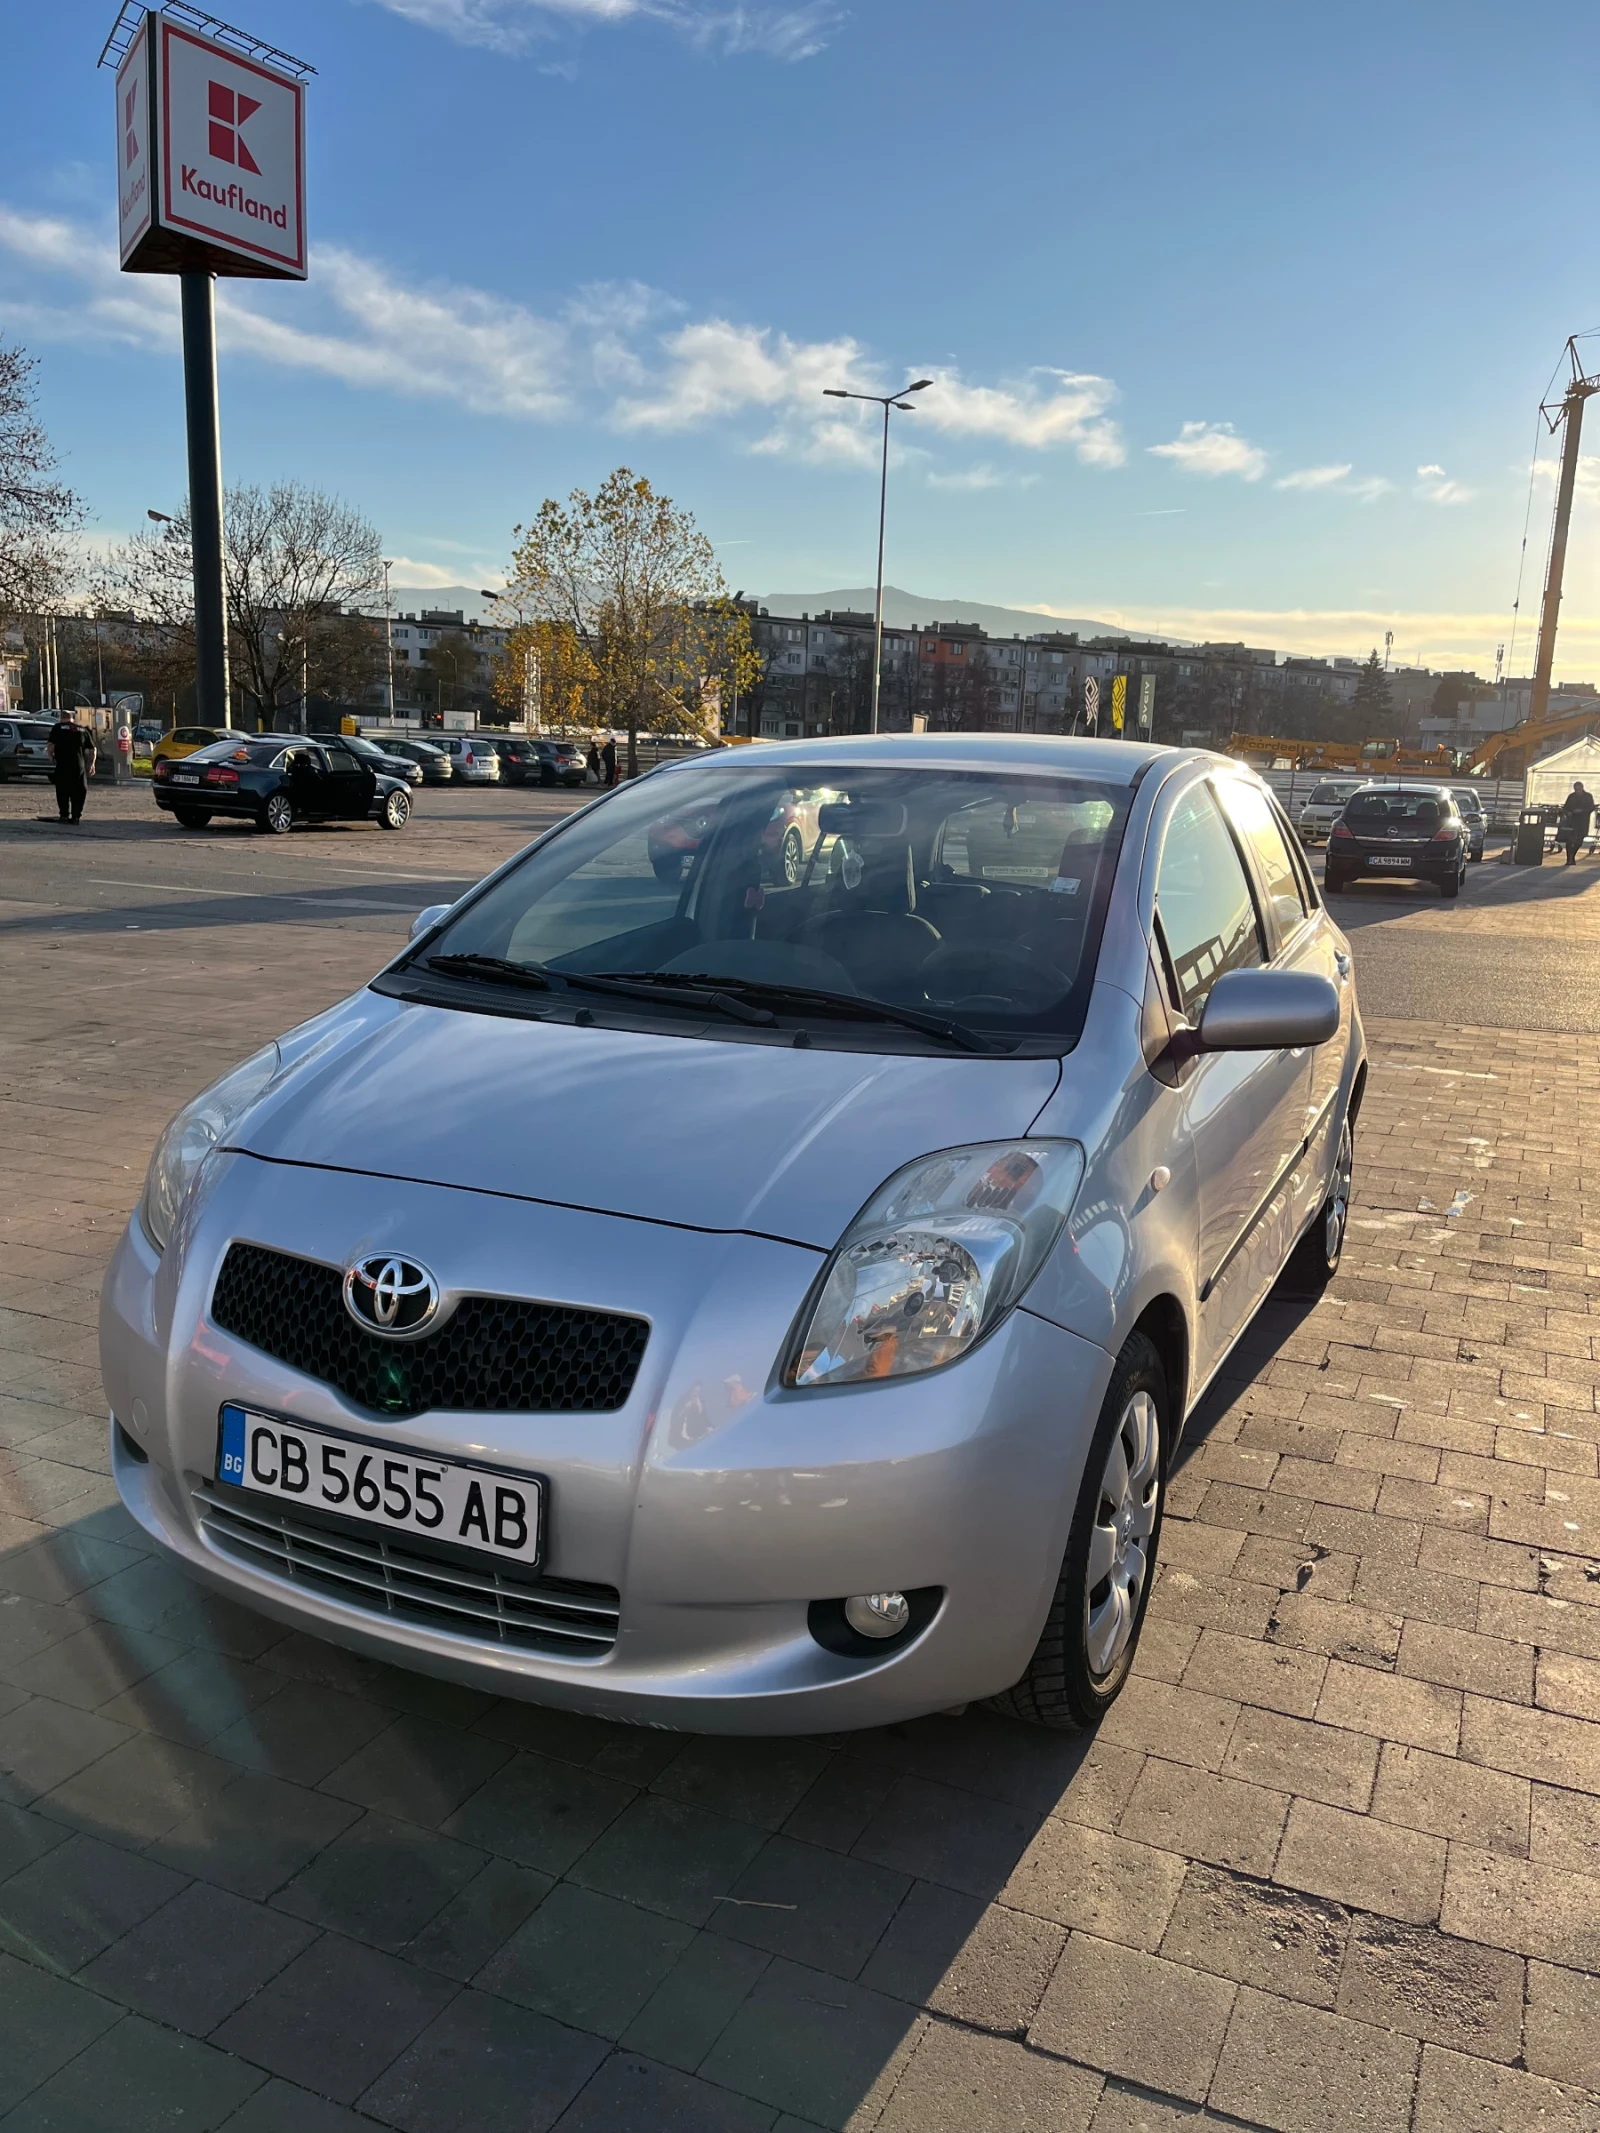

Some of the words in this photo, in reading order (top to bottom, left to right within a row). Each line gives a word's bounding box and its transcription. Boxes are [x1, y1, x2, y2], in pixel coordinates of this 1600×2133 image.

[181, 164, 286, 230] Kaufland
[223, 1453, 242, 1474] BG
[251, 1427, 309, 1493] CB
[321, 1445, 445, 1528] 5655
[459, 1481, 528, 1549] AB
